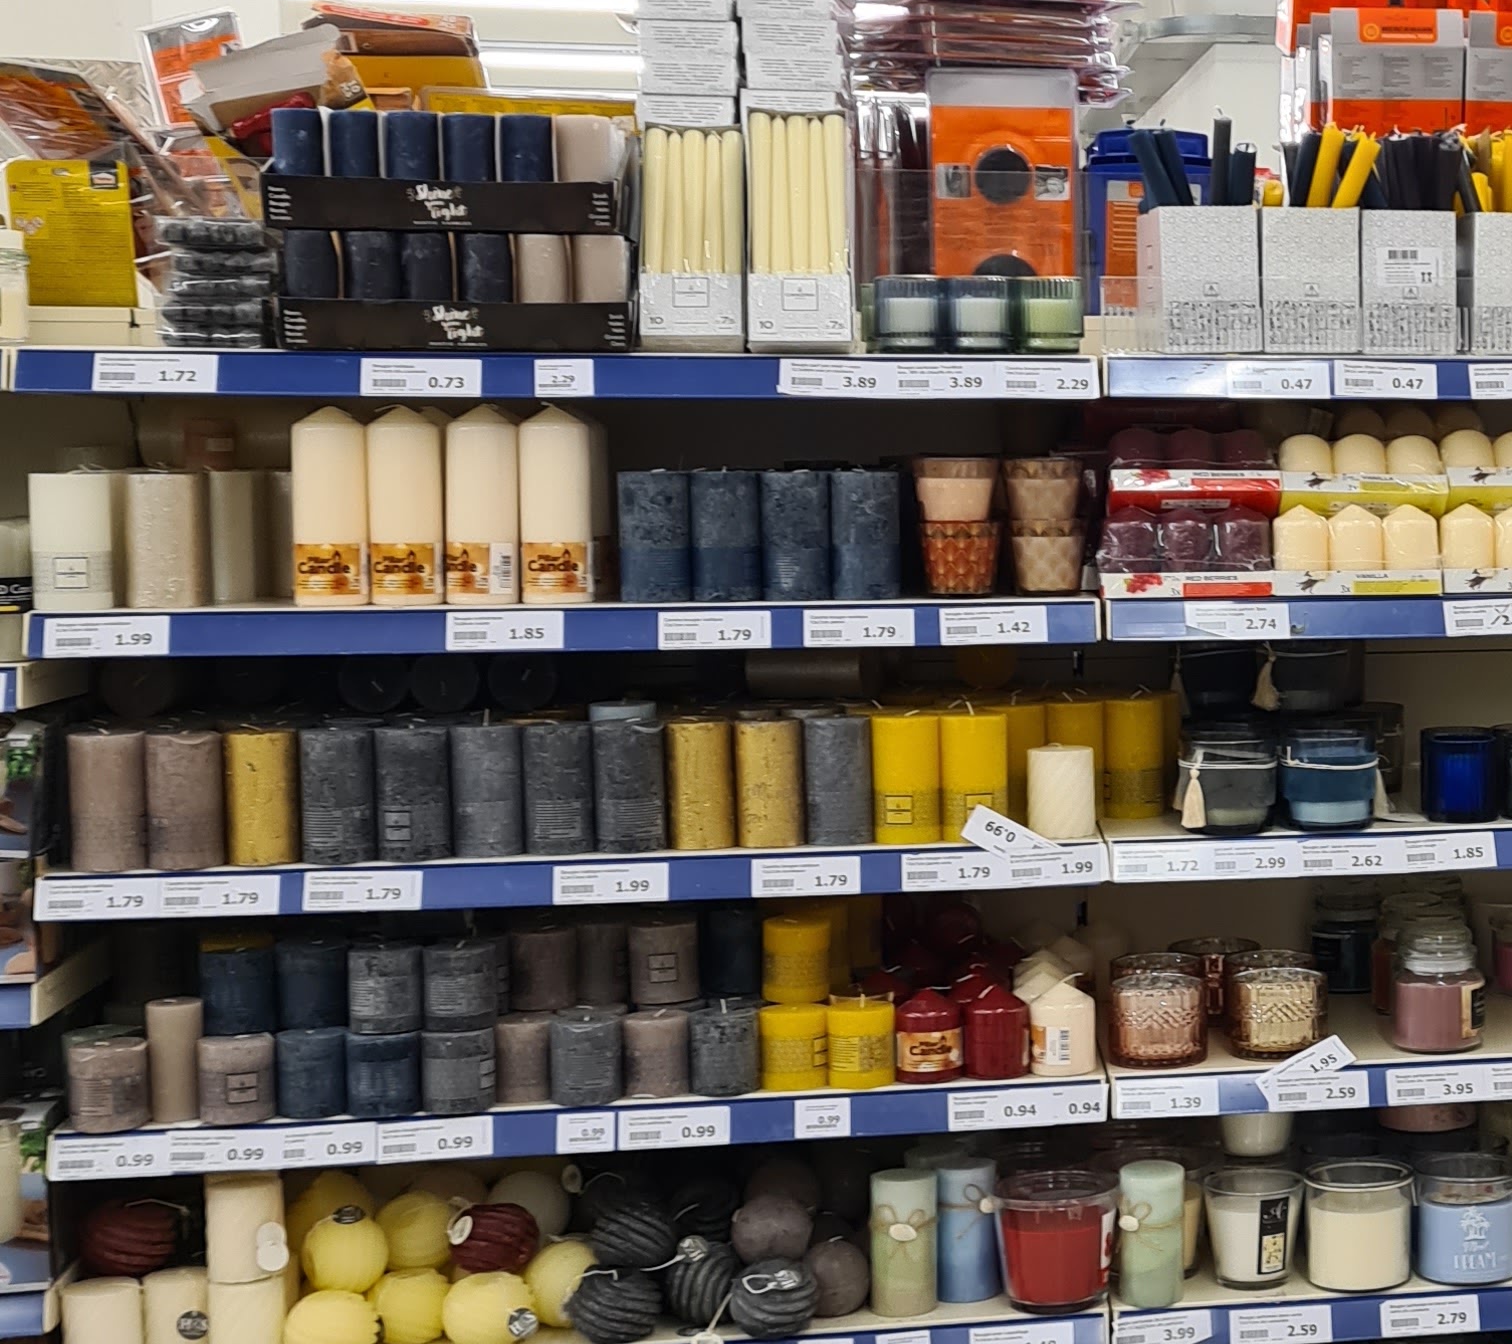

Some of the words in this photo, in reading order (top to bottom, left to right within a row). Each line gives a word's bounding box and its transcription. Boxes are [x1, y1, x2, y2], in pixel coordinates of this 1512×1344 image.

[159, 371, 196, 381] 1.72
[429, 377, 464, 388] 0.73
[843, 377, 876, 388] 3.89
[950, 377, 982, 388] 3.89
[1057, 379, 1088, 390] 2.29
[1281, 379, 1312, 389] 0.47
[1393, 378, 1423, 389] 0.47
[298, 561, 351, 574] Candle
[998, 622, 1030, 633] 1.42
[1246, 619, 1276, 629] 2.74
[510, 628, 544, 639] 1.85
[718, 629, 751, 640] 1.79
[864, 627, 895, 637] 1.79
[116, 633, 152, 645] 1.99
[986, 822, 1015, 842] 0.99
[1454, 847, 1483, 859] 1.85
[1167, 860, 1199, 872] 1.72
[1256, 857, 1285, 868] 2.99
[1352, 856, 1382, 866] 2.62
[959, 867, 990, 878] 1.79
[1062, 861, 1093, 874] 1.99
[616, 880, 649, 892] 1.99
[815, 875, 847, 886] 1.79
[222, 892, 258, 904] 1.79
[366, 888, 401, 899] 1.79
[107, 896, 143, 908] 1.79
[1310, 1054, 1341, 1073] 1.95
[1326, 1087, 1355, 1099] 2.59
[1443, 1083, 1473, 1095] 3.95
[1069, 1102, 1100, 1114] 0.94
[1171, 1097, 1201, 1108] 1.39
[1004, 1105, 1036, 1117] 0.94
[682, 1125, 715, 1138] 0.99
[327, 1142, 362, 1155] 0.99
[438, 1136, 473, 1150] 0.99
[227, 1148, 263, 1160] 0.99
[116, 1154, 153, 1167] 0.99
[1437, 1312, 1466, 1324] 2.79
[1164, 1327, 1195, 1341] 3.99
[1288, 1324, 1317, 1336] 2.59
